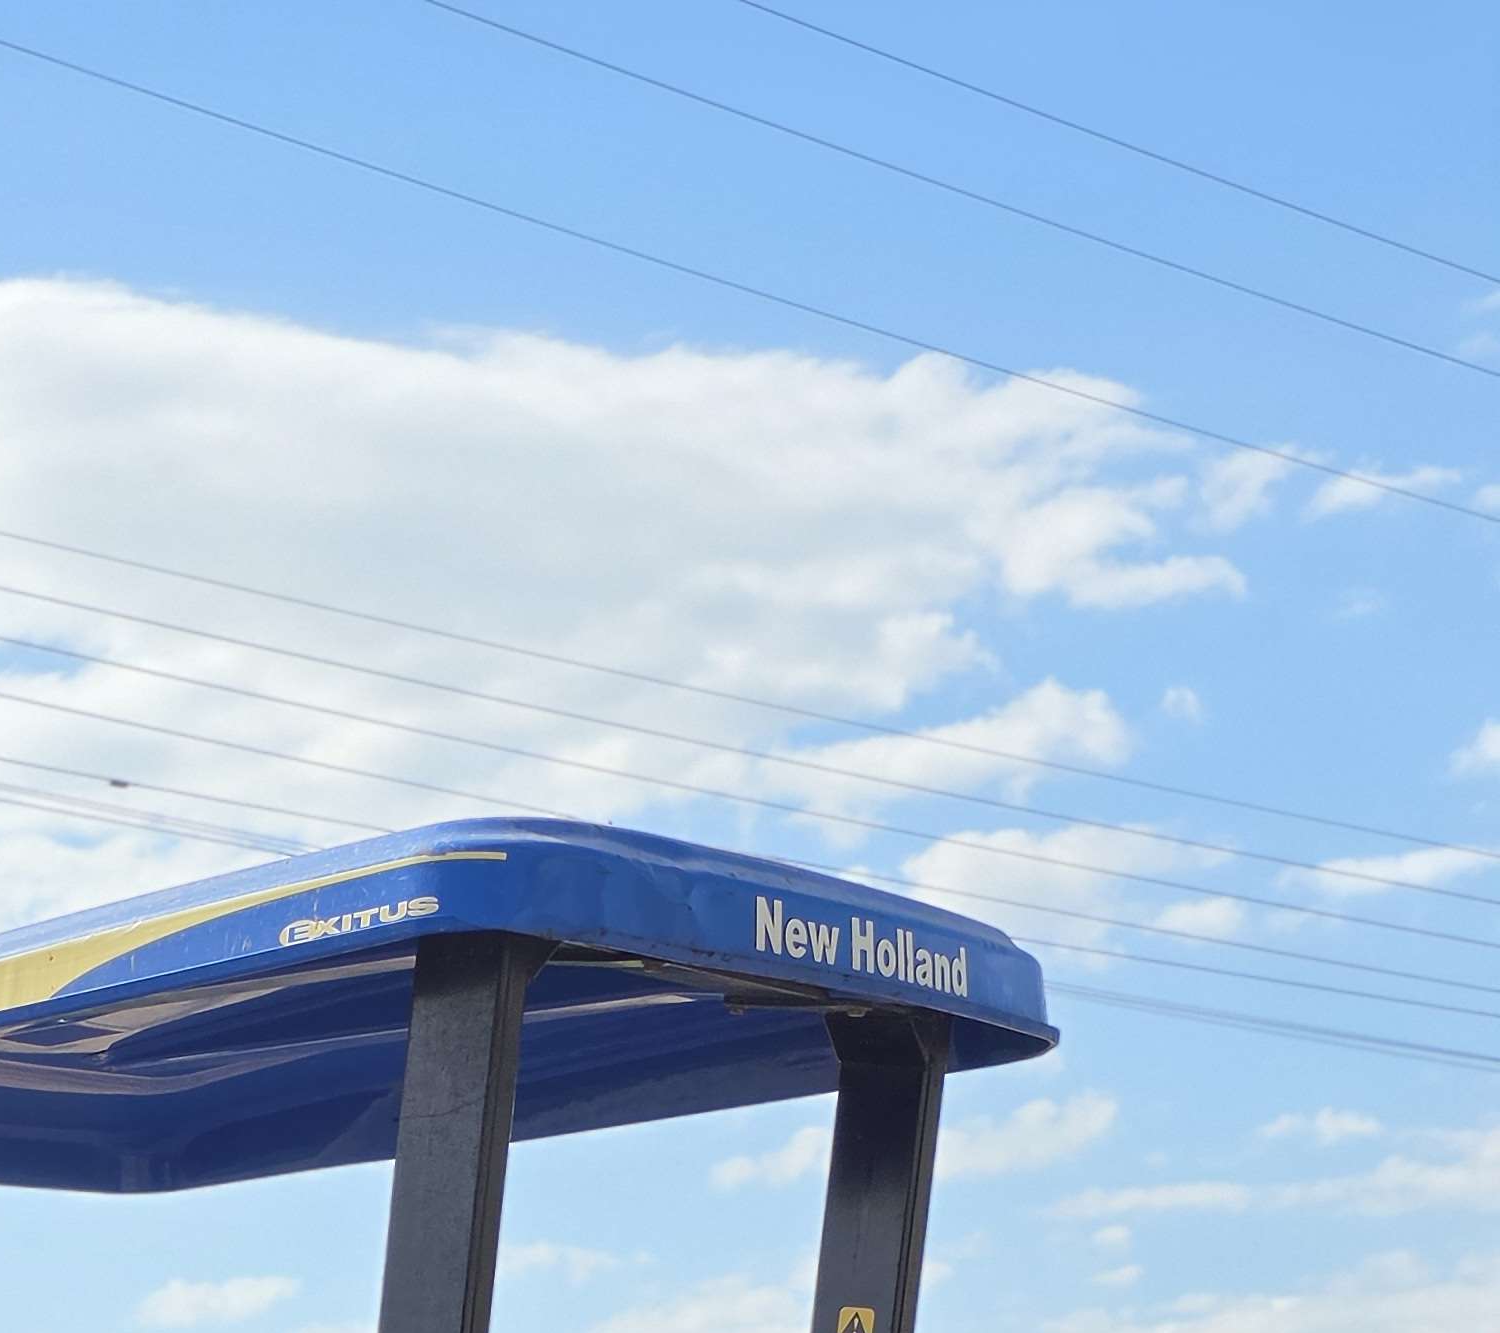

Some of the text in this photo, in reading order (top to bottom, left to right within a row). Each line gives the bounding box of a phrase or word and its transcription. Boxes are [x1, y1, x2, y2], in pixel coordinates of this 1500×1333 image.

[278, 895, 439, 946] EXITUS
[755, 895, 968, 998] New Holland
